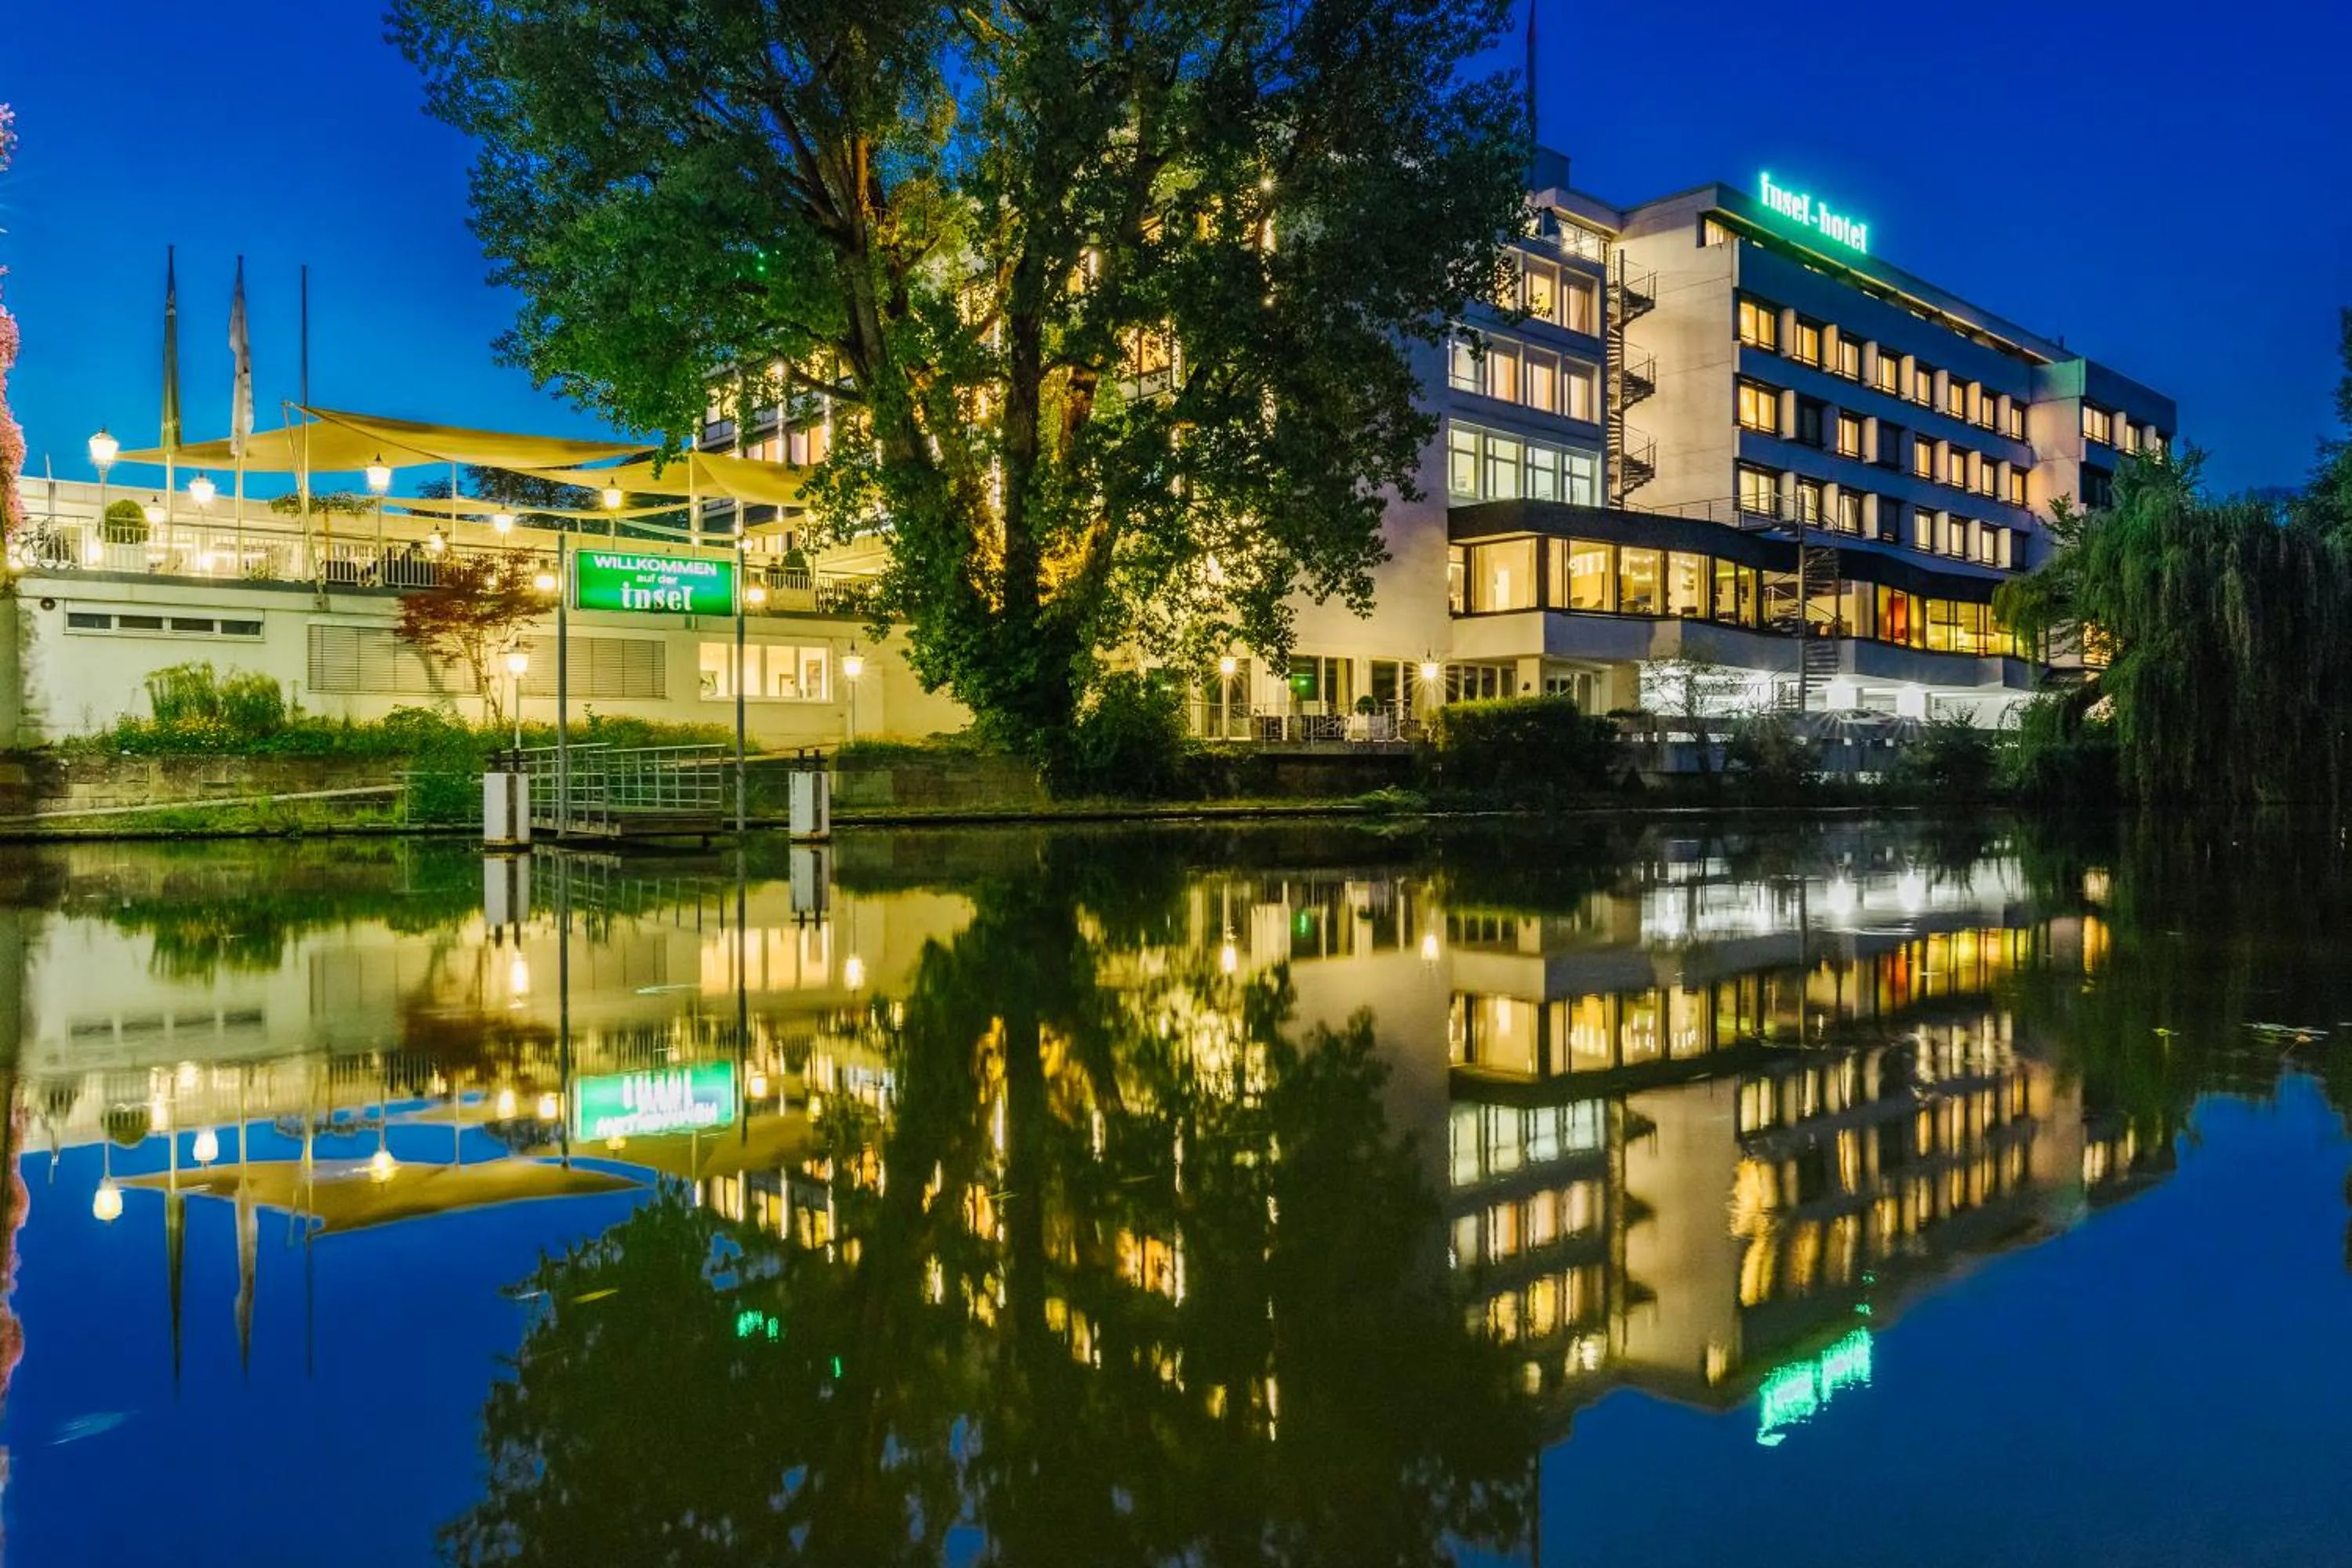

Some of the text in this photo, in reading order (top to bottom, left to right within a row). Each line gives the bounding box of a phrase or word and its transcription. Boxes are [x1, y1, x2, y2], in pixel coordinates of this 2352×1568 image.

[593, 555, 717, 576] WILLKOMMEN
[636, 573, 677, 585] auf der
[621, 582, 694, 611] insel
